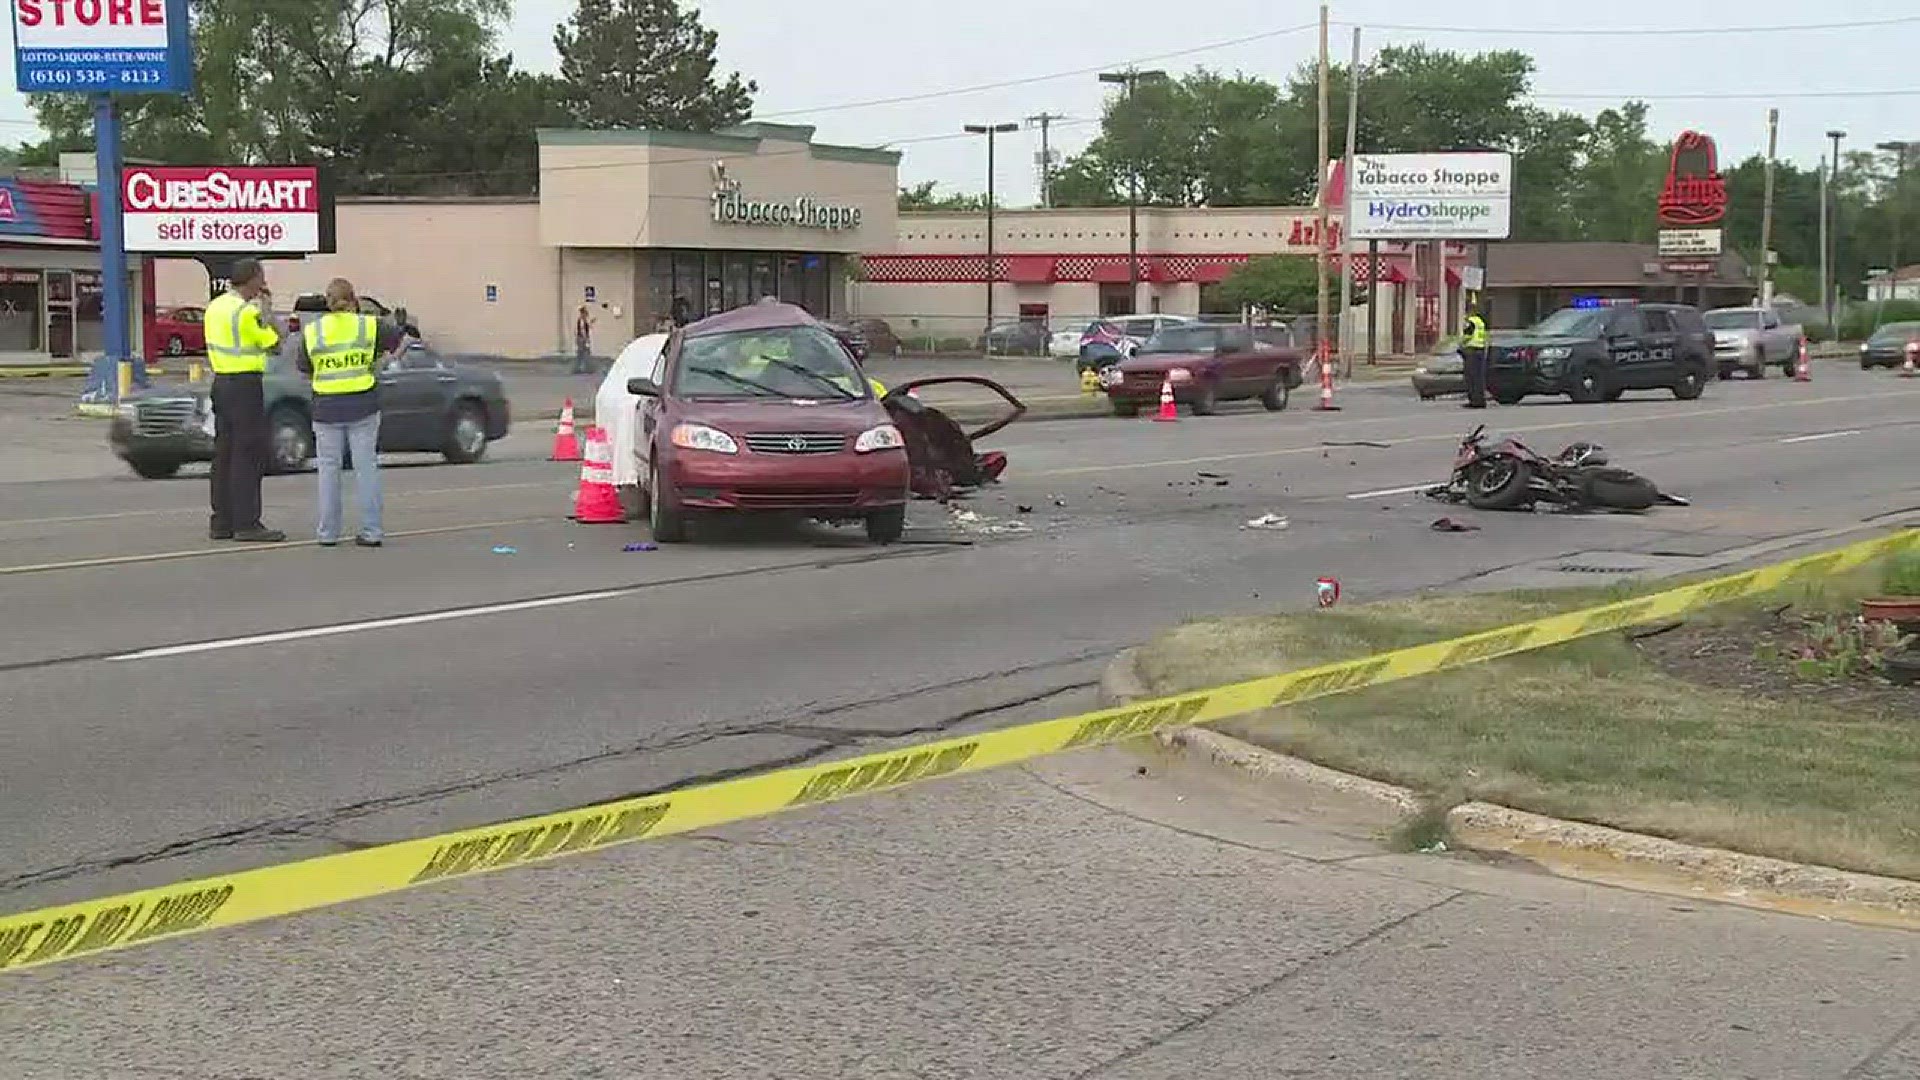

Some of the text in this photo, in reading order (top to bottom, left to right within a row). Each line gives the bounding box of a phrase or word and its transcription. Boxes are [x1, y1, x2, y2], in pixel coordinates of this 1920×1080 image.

[18, 0, 164, 26] STORE
[30, 69, 71, 83] (616)
[76, 69, 106, 83] 538
[121, 69, 160, 83] 8113
[1357, 169, 1500, 186] Tobacco Shoppe
[158, 218, 283, 245] self storage
[1615, 350, 1673, 363] POLICE
